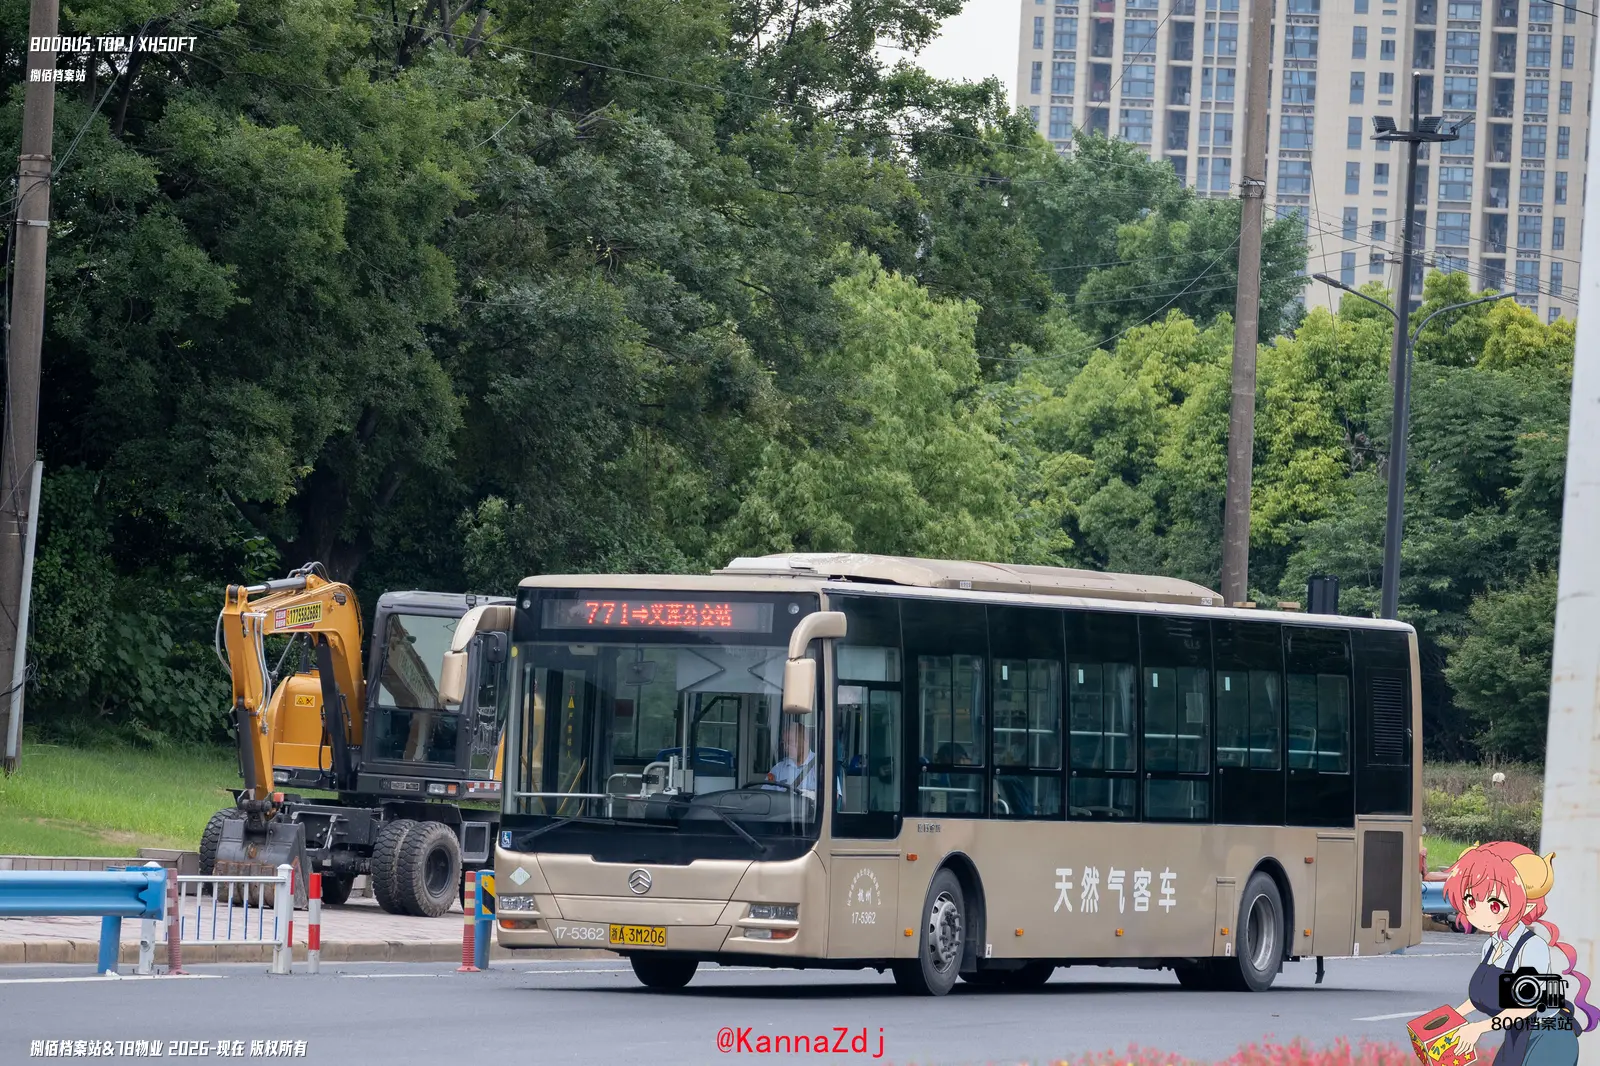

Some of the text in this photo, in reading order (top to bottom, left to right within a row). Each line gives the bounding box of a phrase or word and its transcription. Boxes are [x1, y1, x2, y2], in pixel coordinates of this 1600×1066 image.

[585, 601, 629, 625] 771
[1053, 865, 1178, 914] 天然气客车
[851, 911, 876, 925] 17-5362
[554, 926, 604, 941] 17-5362
